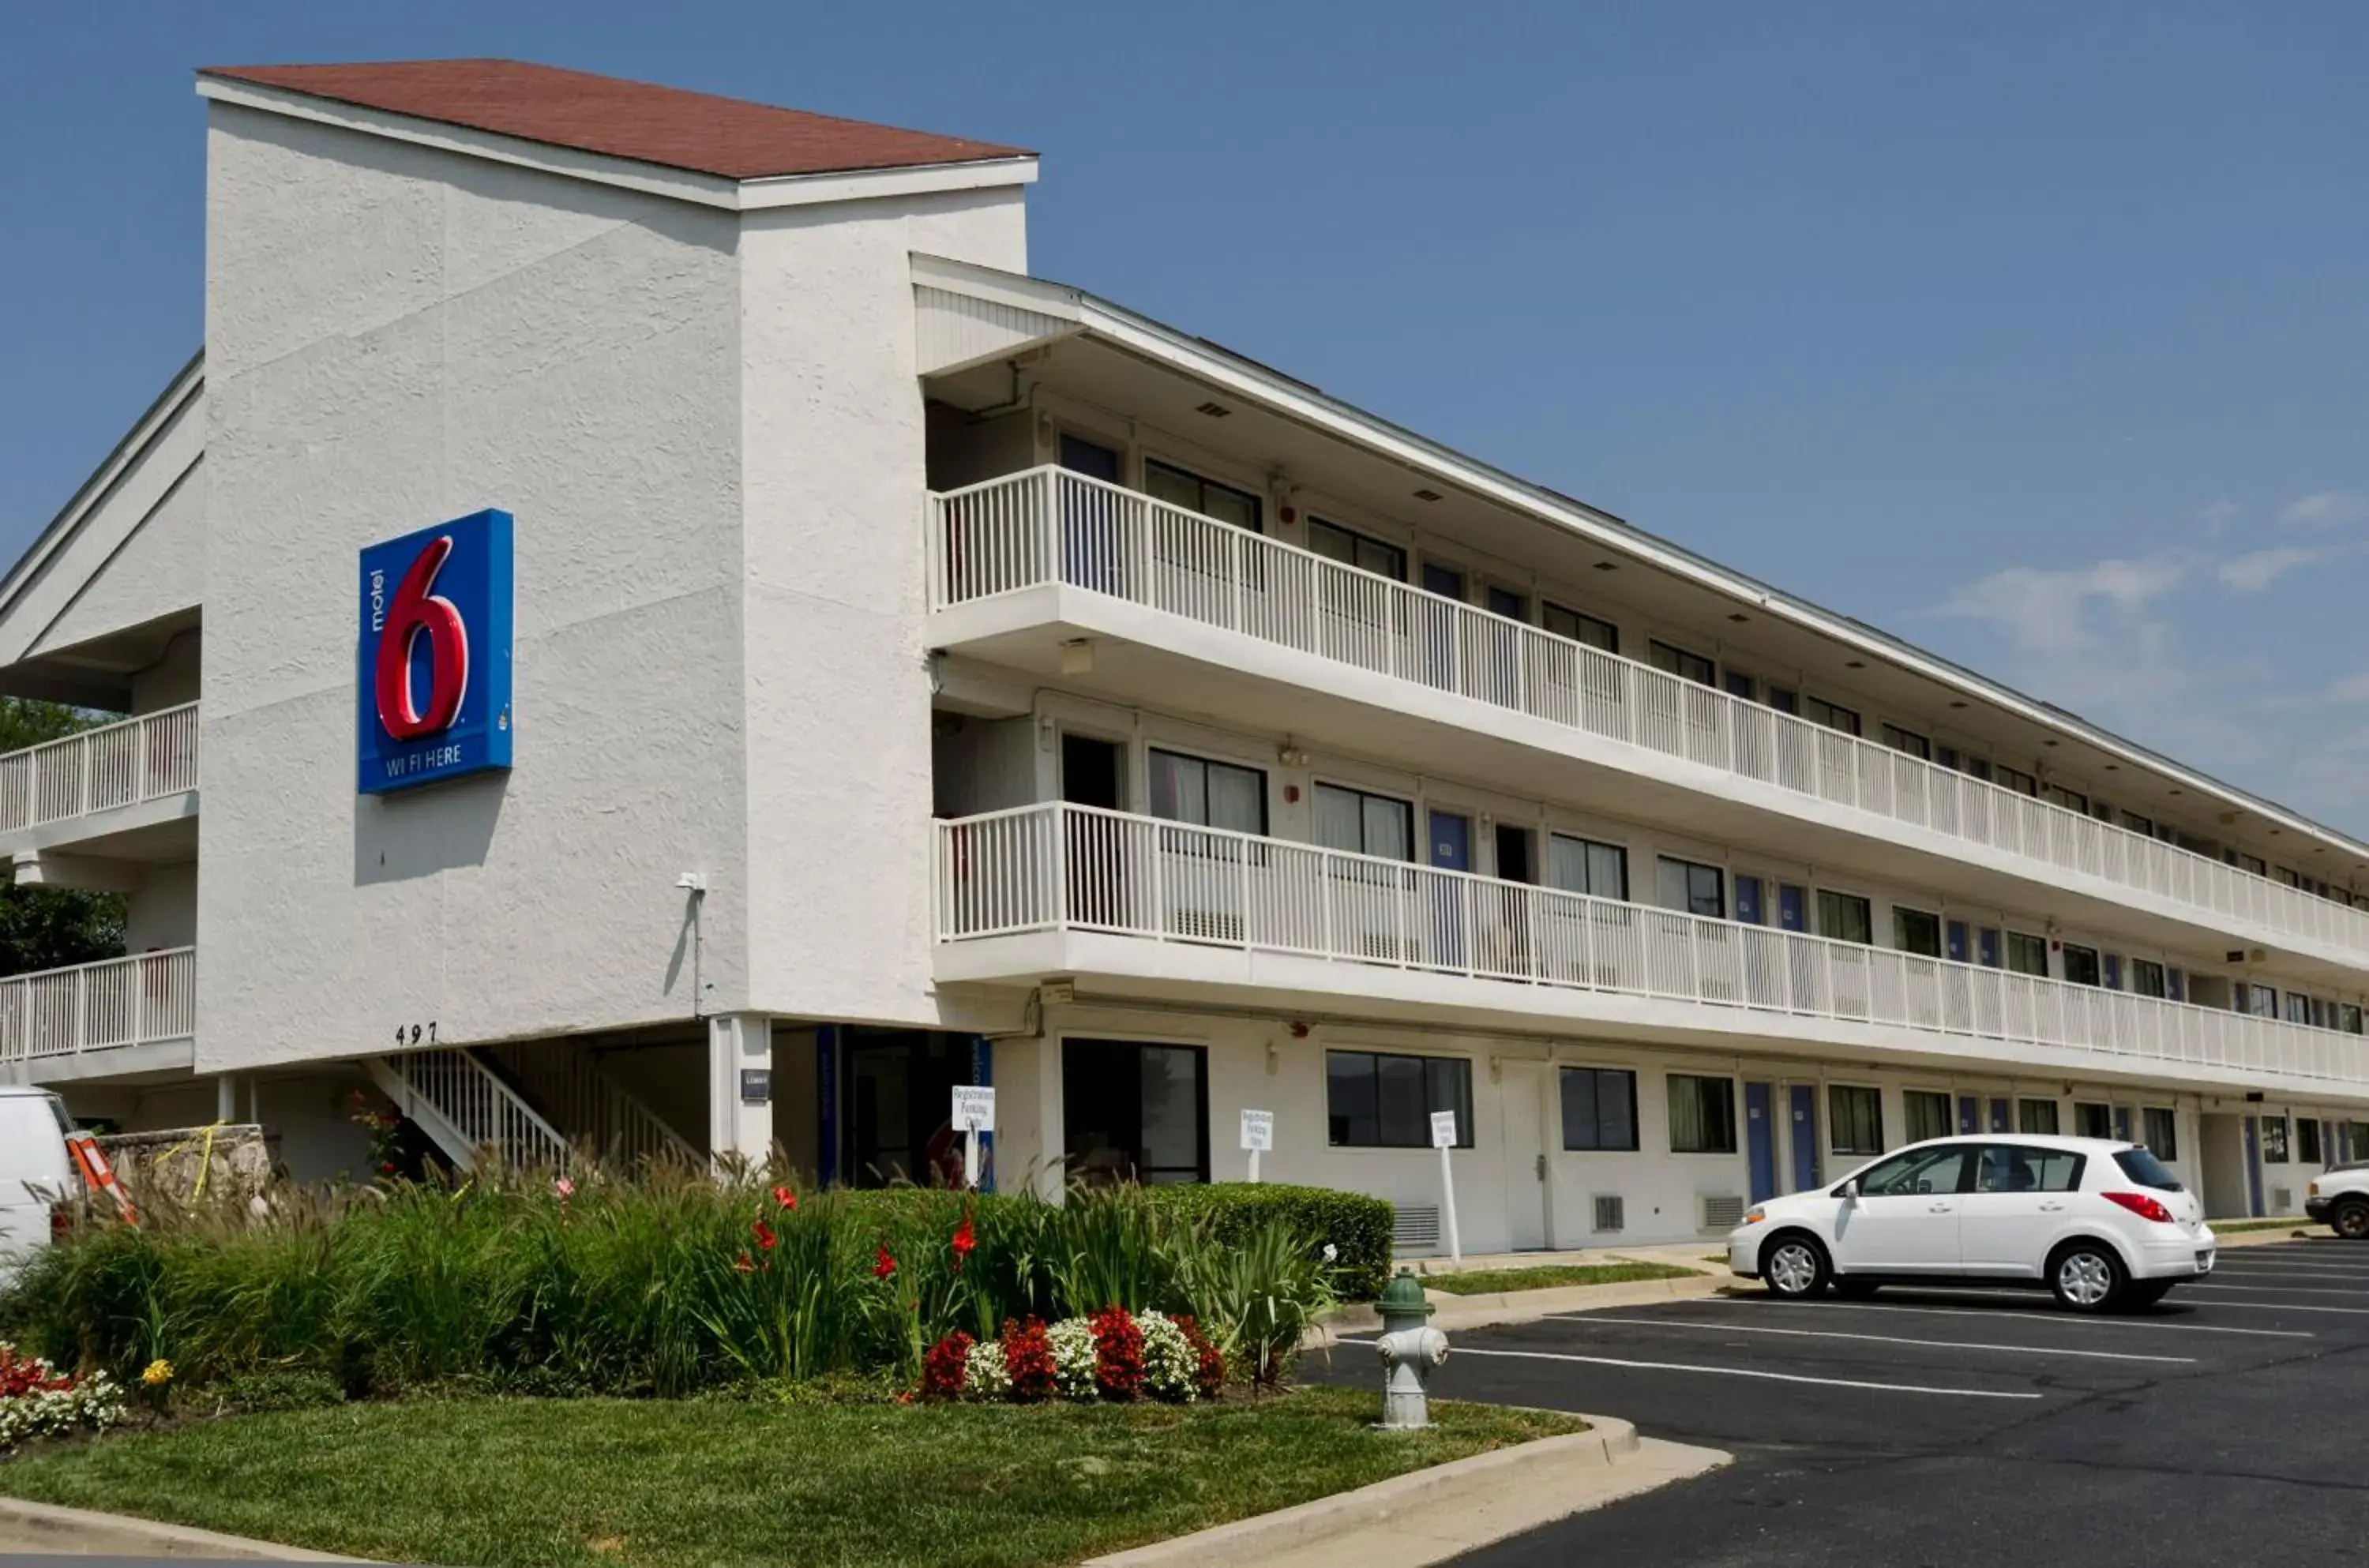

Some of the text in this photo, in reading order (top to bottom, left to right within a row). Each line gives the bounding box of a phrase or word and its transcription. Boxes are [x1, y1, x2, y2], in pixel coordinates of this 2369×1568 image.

[370, 569, 384, 632] motel
[375, 535, 469, 741] 6
[386, 745, 462, 778] WI FI HERE
[396, 1021, 437, 1046] 497
